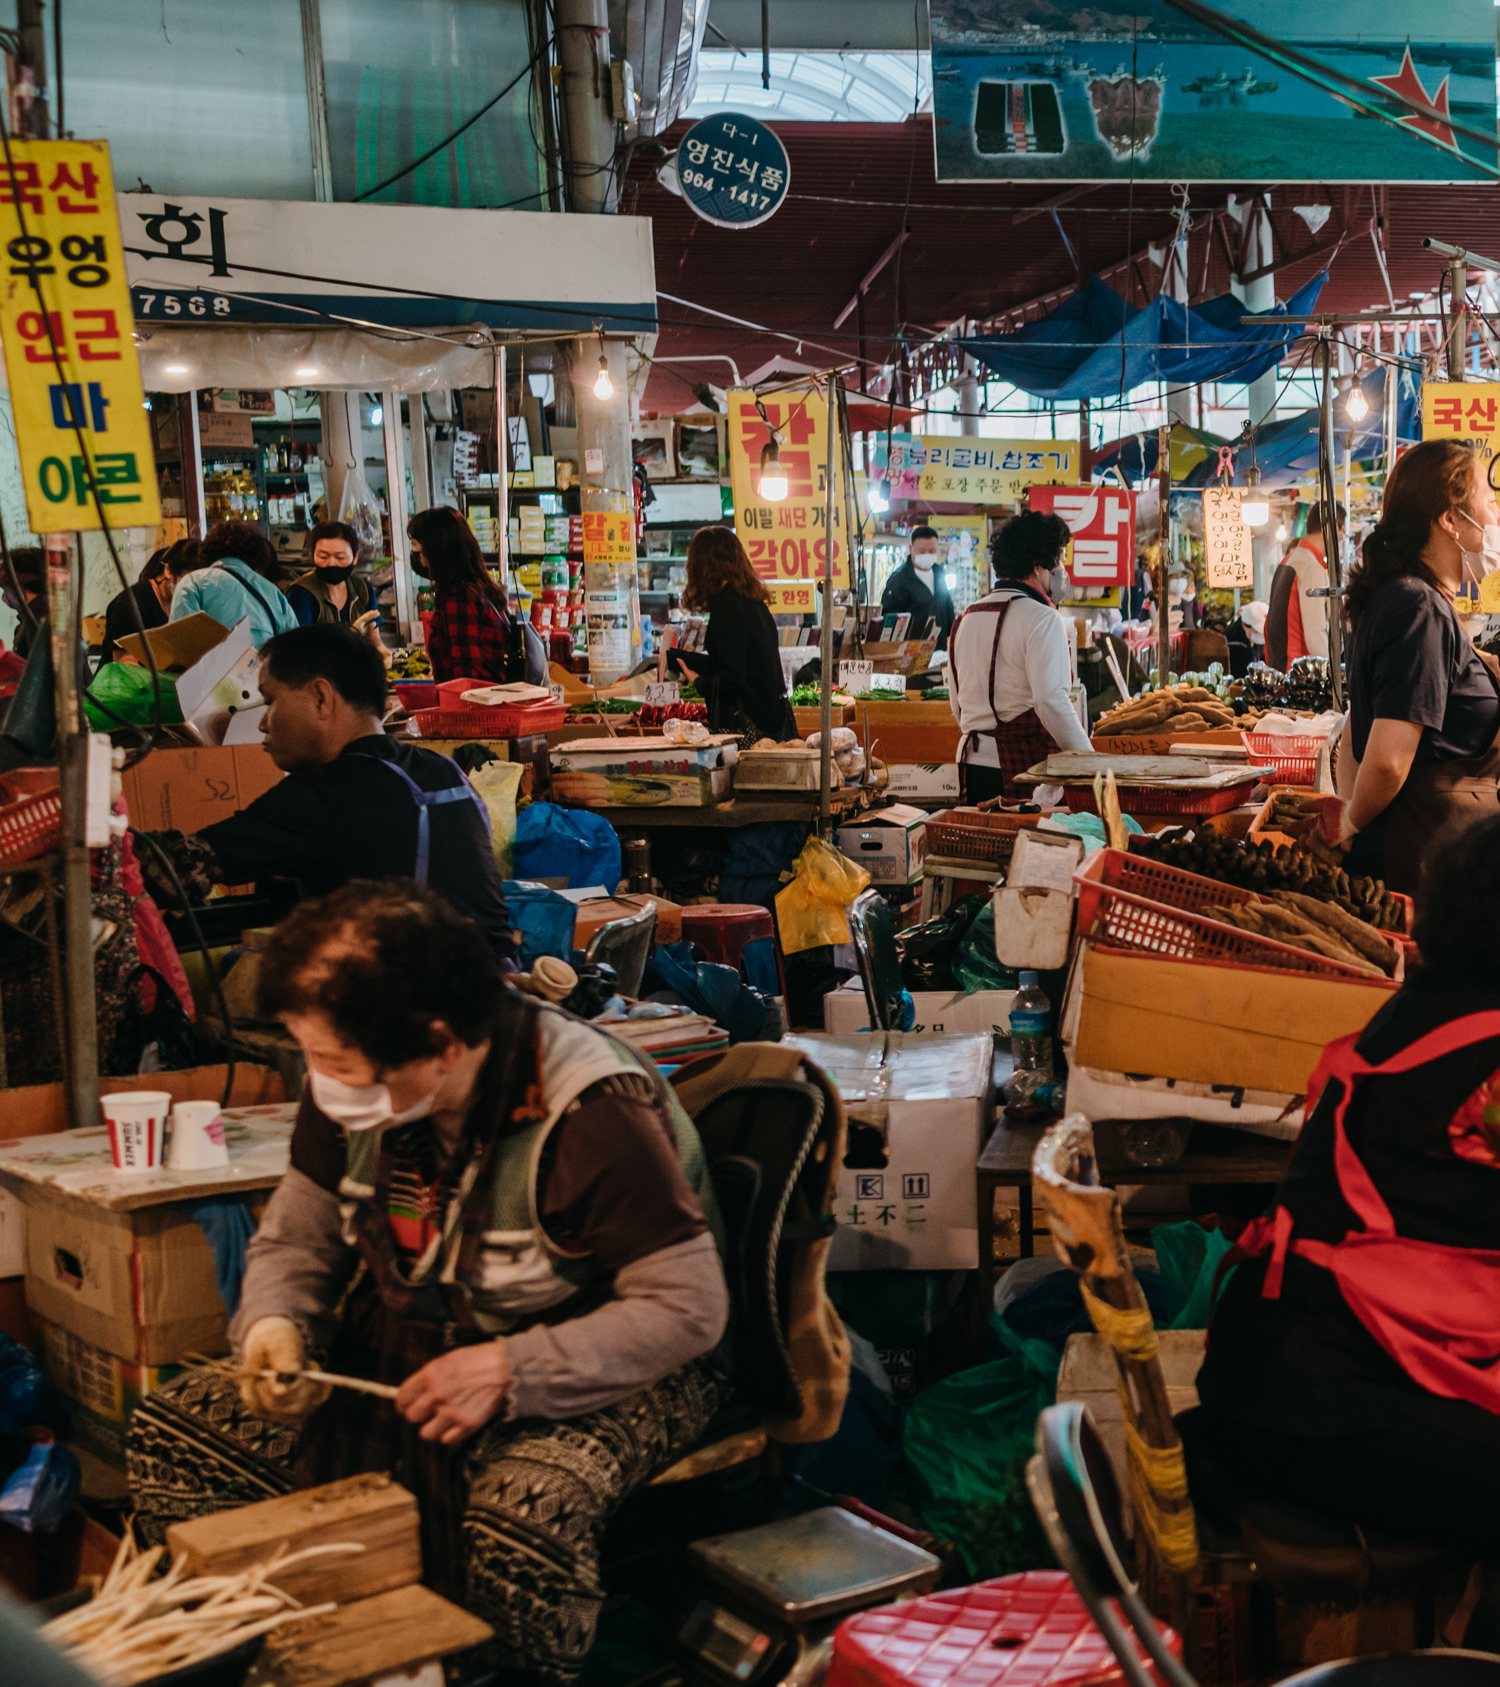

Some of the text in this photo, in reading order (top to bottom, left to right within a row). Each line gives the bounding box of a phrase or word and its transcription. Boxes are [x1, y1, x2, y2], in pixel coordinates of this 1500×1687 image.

[686, 139, 784, 192] 영진식품
[7, 234, 110, 289] 우엉
[136, 202, 234, 278] 회
[16, 309, 122, 363] 연근
[48, 381, 110, 433] 마
[1433, 398, 1498, 432] 국산
[38, 452, 142, 507] 야콘
[744, 507, 773, 529] 이발
[778, 507, 807, 529] 재단
[1053, 496, 1129, 578] 칼
[748, 537, 842, 580] 갈아요
[782, 590, 810, 606] 환영
